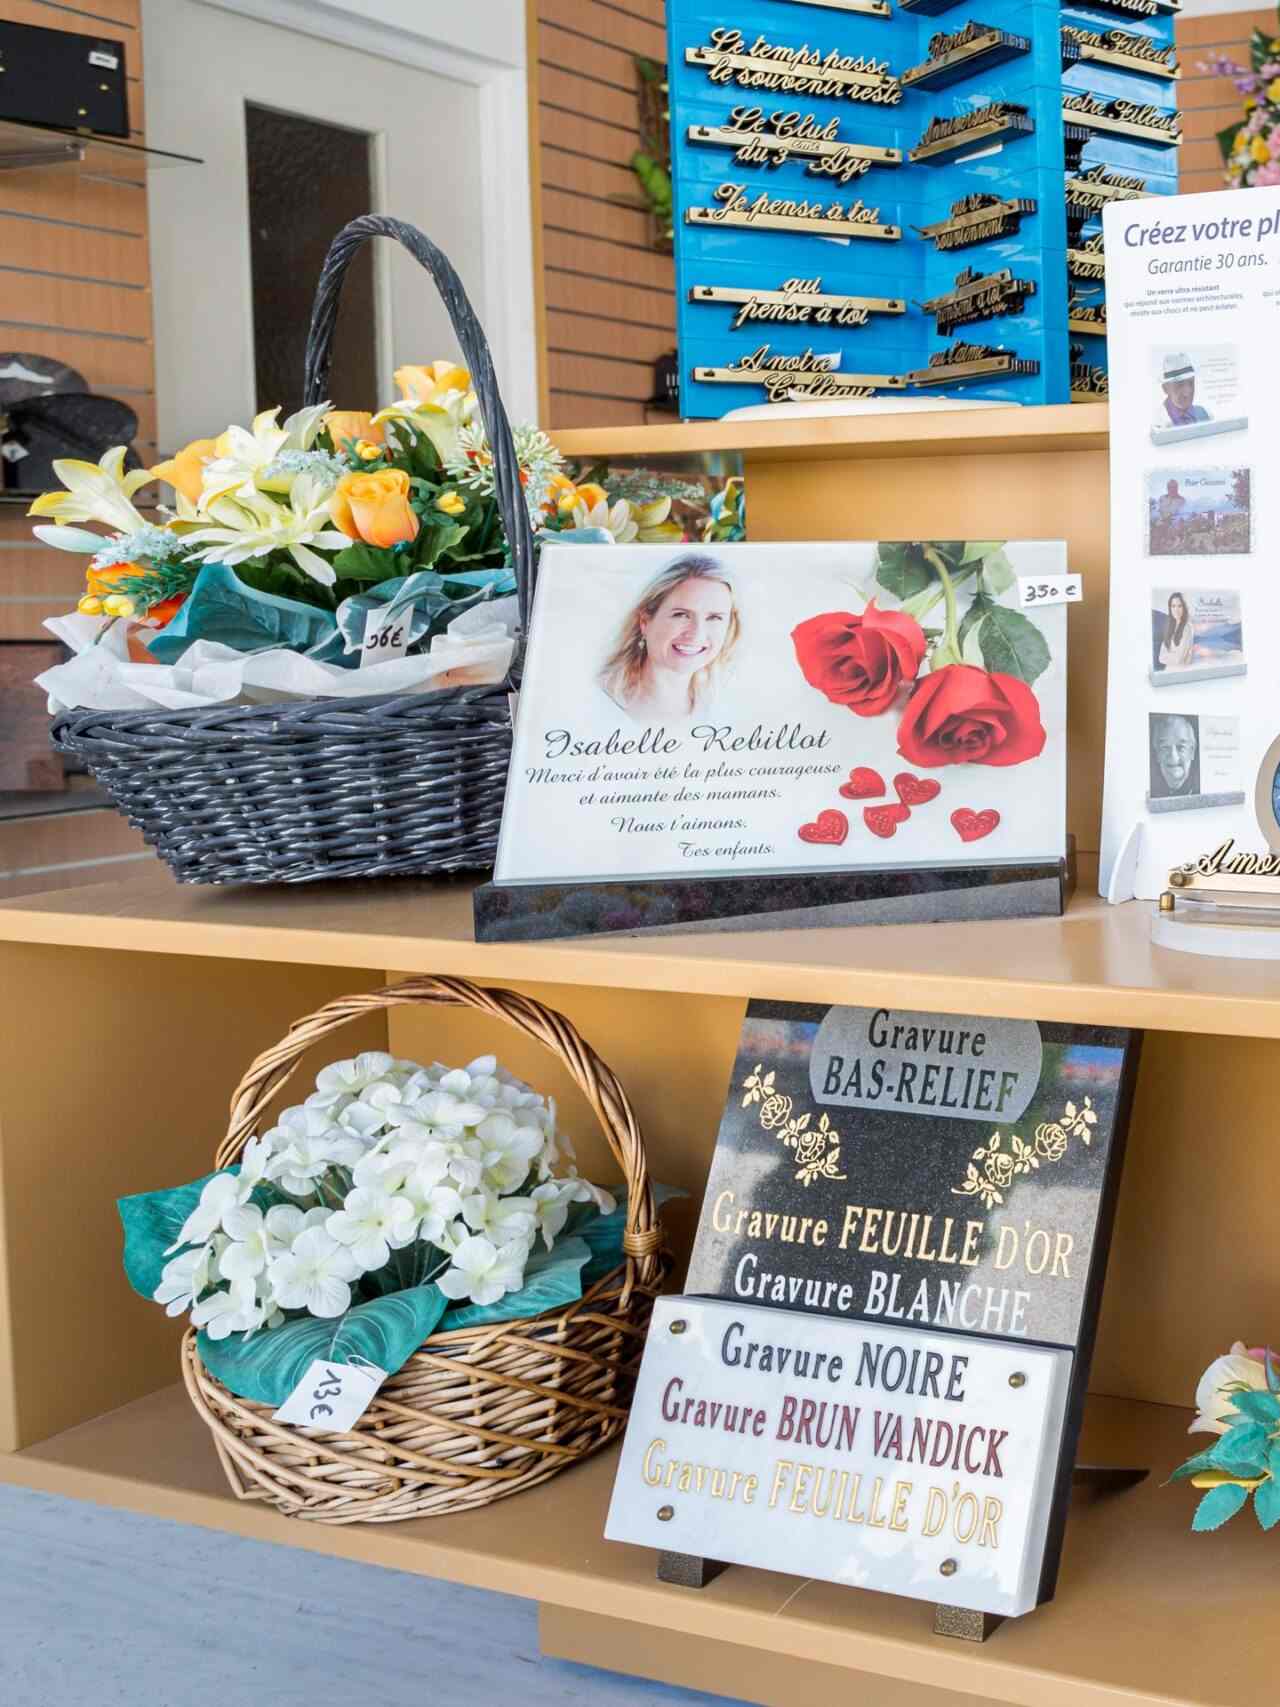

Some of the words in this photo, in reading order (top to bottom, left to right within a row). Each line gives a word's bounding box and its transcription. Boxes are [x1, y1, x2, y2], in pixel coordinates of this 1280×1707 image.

[702, 28, 745, 55] Le
[748, 35, 821, 71] temps
[820, 50, 890, 75] passe
[708, 58, 734, 81] le
[737, 69, 844, 97] souvenir
[847, 81, 902, 105] reste
[720, 105, 765, 133] Le
[770, 111, 841, 140] Club
[735, 138, 768, 162] du
[809, 146, 872, 181] Age
[713, 184, 747, 219] Je
[748, 192, 818, 221] pense
[848, 200, 879, 223] toi
[1124, 220, 1187, 247] Créez
[1192, 216, 1252, 241] votre
[1147, 254, 1212, 275] Garantie
[1216, 252, 1234, 270] 30
[1237, 252, 1268, 268] ans.
[782, 277, 821, 300] qui
[735, 296, 811, 327] pense
[836, 301, 869, 325] toi
[728, 344, 771, 372] A
[767, 348, 834, 372] notre
[1024, 584, 1059, 602] 350
[544, 726, 683, 759] Isabelle
[525, 766, 583, 784] Merci
[587, 762, 648, 783] d'avoir
[653, 764, 678, 780] été
[682, 761, 700, 779] la
[703, 760, 744, 784] plus
[748, 763, 842, 782] courageuse
[578, 792, 594, 806] et
[599, 790, 669, 806] aimante
[673, 787, 701, 803] des
[705, 786, 782, 802] mamans.
[610, 815, 666, 833] Nous
[669, 813, 748, 832] t'aimons.
[678, 841, 711, 858] Tes
[715, 840, 775, 861] enfants.
[1183, 839, 1234, 876] A
[868, 1007, 987, 1058] Gravure
[822, 1055, 1021, 1114] BAS-RELIEF
[712, 1190, 829, 1247] Gravure
[838, 1205, 984, 1266] FEUILLE
[993, 1219, 1074, 1279] D'OR
[735, 1253, 854, 1311] Gravure
[864, 1270, 1031, 1337] BLANCHE
[720, 1321, 843, 1383] Gravure
[855, 1341, 969, 1402] NOIRE
[660, 1377, 768, 1437] Gravure
[775, 1396, 861, 1452] BRUN
[872, 1411, 1010, 1478] VANDICK
[640, 1438, 760, 1505] Gravure
[768, 1459, 914, 1532] FEUILLE
[921, 1483, 1003, 1550] D'OR
